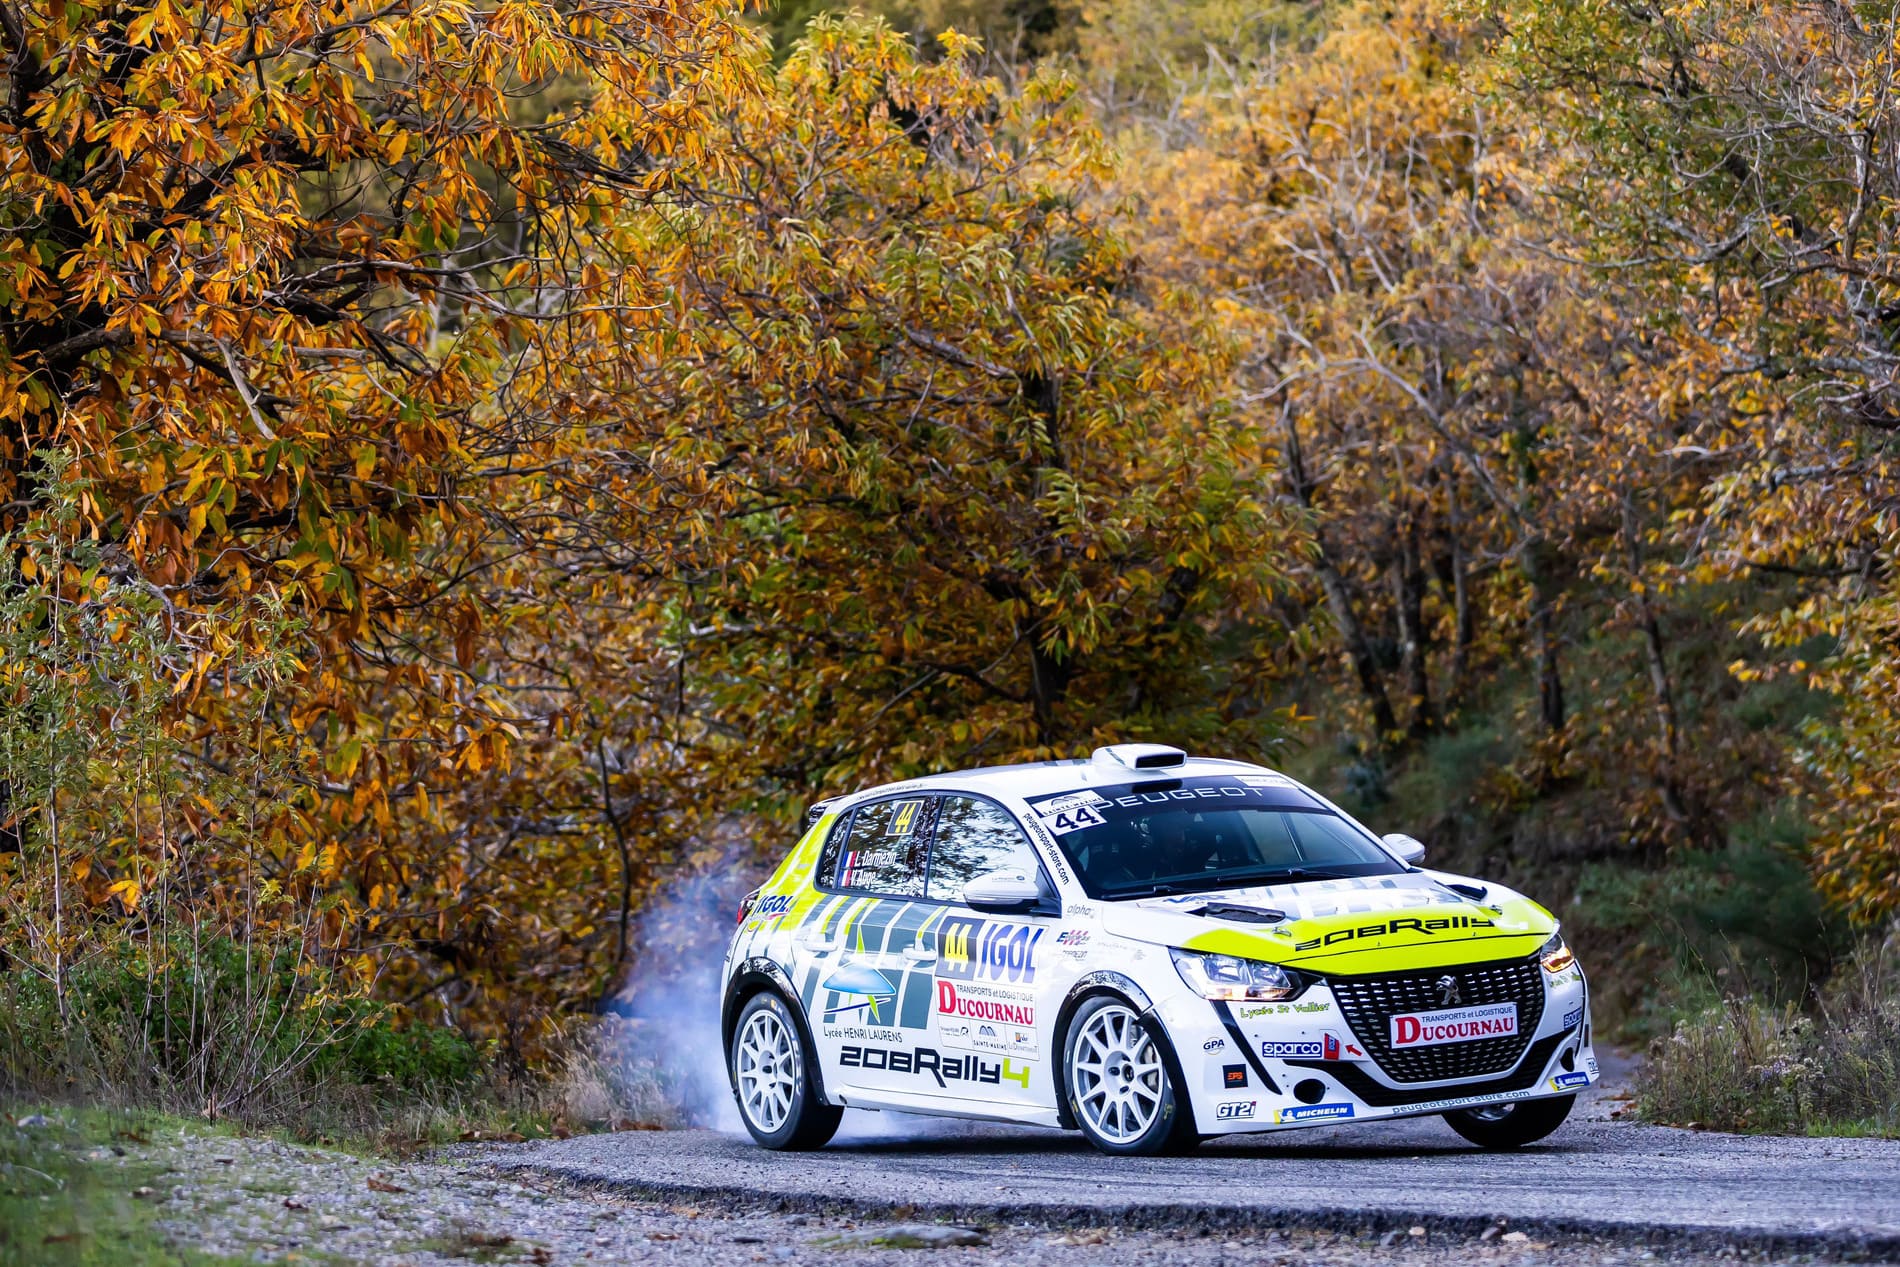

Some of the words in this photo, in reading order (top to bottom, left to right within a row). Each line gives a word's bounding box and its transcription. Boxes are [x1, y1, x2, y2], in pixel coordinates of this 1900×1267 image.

[1090, 787, 1264, 813] PEUGEOT
[895, 803, 917, 832] 44
[1055, 807, 1100, 830] 44
[1023, 812, 1070, 886] peugeotsport-store.com
[944, 922, 973, 973] 44
[978, 924, 1045, 984] IGOL
[937, 980, 1034, 1025] DUCOURNAU
[956, 984, 992, 997] TRANSPORTS
[999, 990, 1034, 1003] LOGISTIQUE
[1422, 1012, 1466, 1023] TRANSPORTS
[1475, 1006, 1513, 1018] LOGISTIQUE
[824, 1026, 842, 1039] Lycée
[844, 1027, 867, 1040] HENRI
[868, 1029, 903, 1043] LAURENS
[1395, 1016, 1514, 1044] DUCOURNAU
[1203, 1038, 1225, 1051] GPA
[1263, 1043, 1321, 1058] sparco
[1217, 1102, 1257, 1117] GT2i
[1297, 1107, 1348, 1119] MICHELIN
[1392, 1090, 1530, 1114] peugeotsport-store.com
